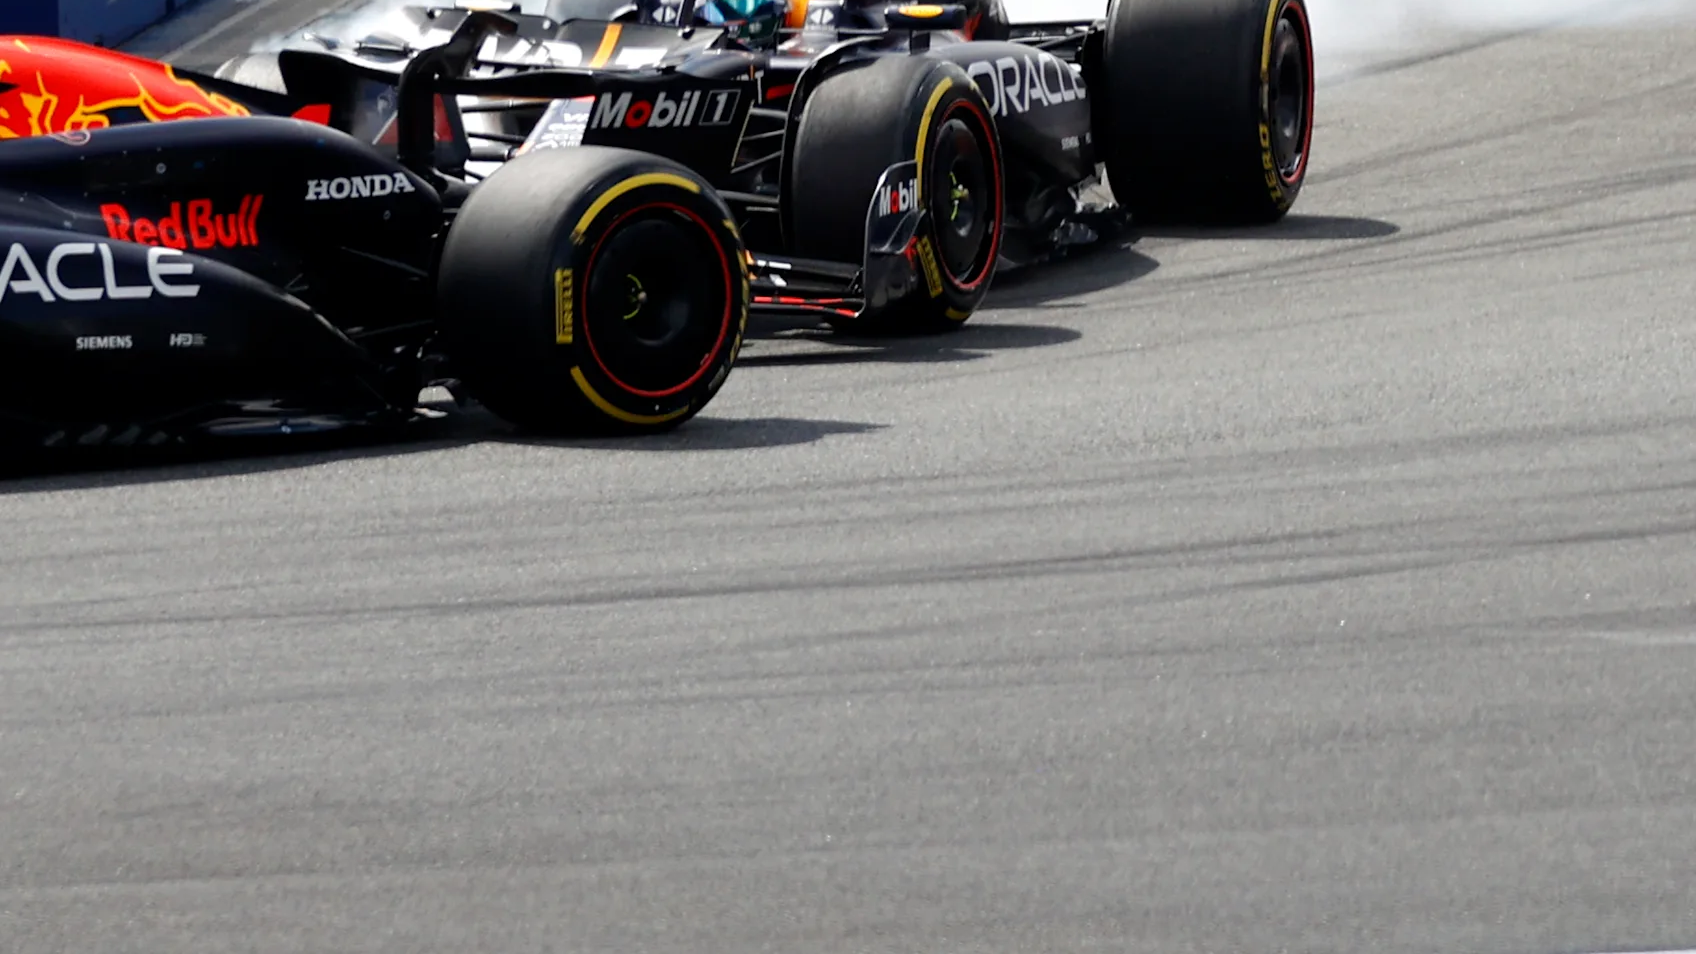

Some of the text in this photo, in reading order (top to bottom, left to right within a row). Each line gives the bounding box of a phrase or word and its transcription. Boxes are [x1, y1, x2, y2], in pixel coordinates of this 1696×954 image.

[590, 90, 702, 129] Mobil
[305, 172, 415, 201] HONDA
[879, 177, 919, 217] Mobil
[75, 335, 133, 350] SIEMENS
